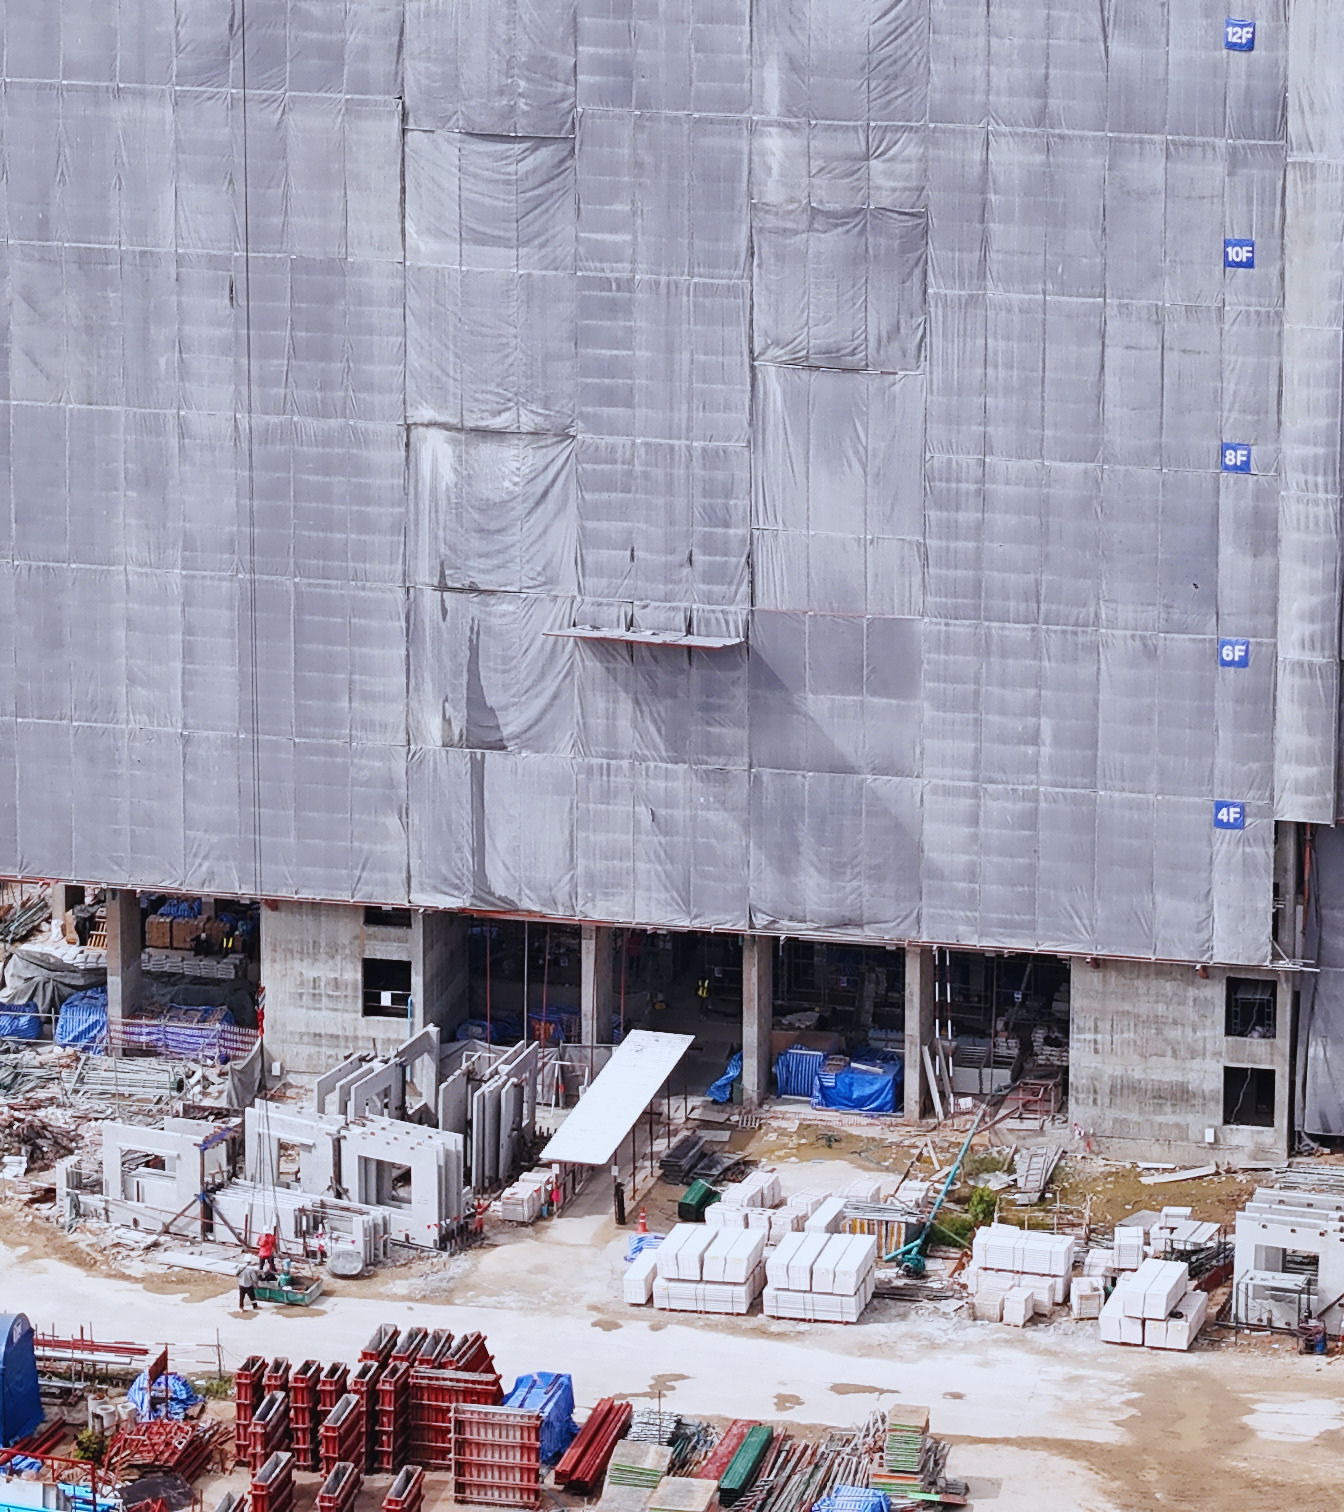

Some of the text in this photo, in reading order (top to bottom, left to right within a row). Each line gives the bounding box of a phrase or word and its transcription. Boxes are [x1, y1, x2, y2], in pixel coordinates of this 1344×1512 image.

[1226, 26, 1252, 44] 12F
[1226, 245, 1253, 263] 10F
[1224, 449, 1248, 466] 8F
[1221, 644, 1246, 661] 6F
[1217, 805, 1241, 824] 4F
